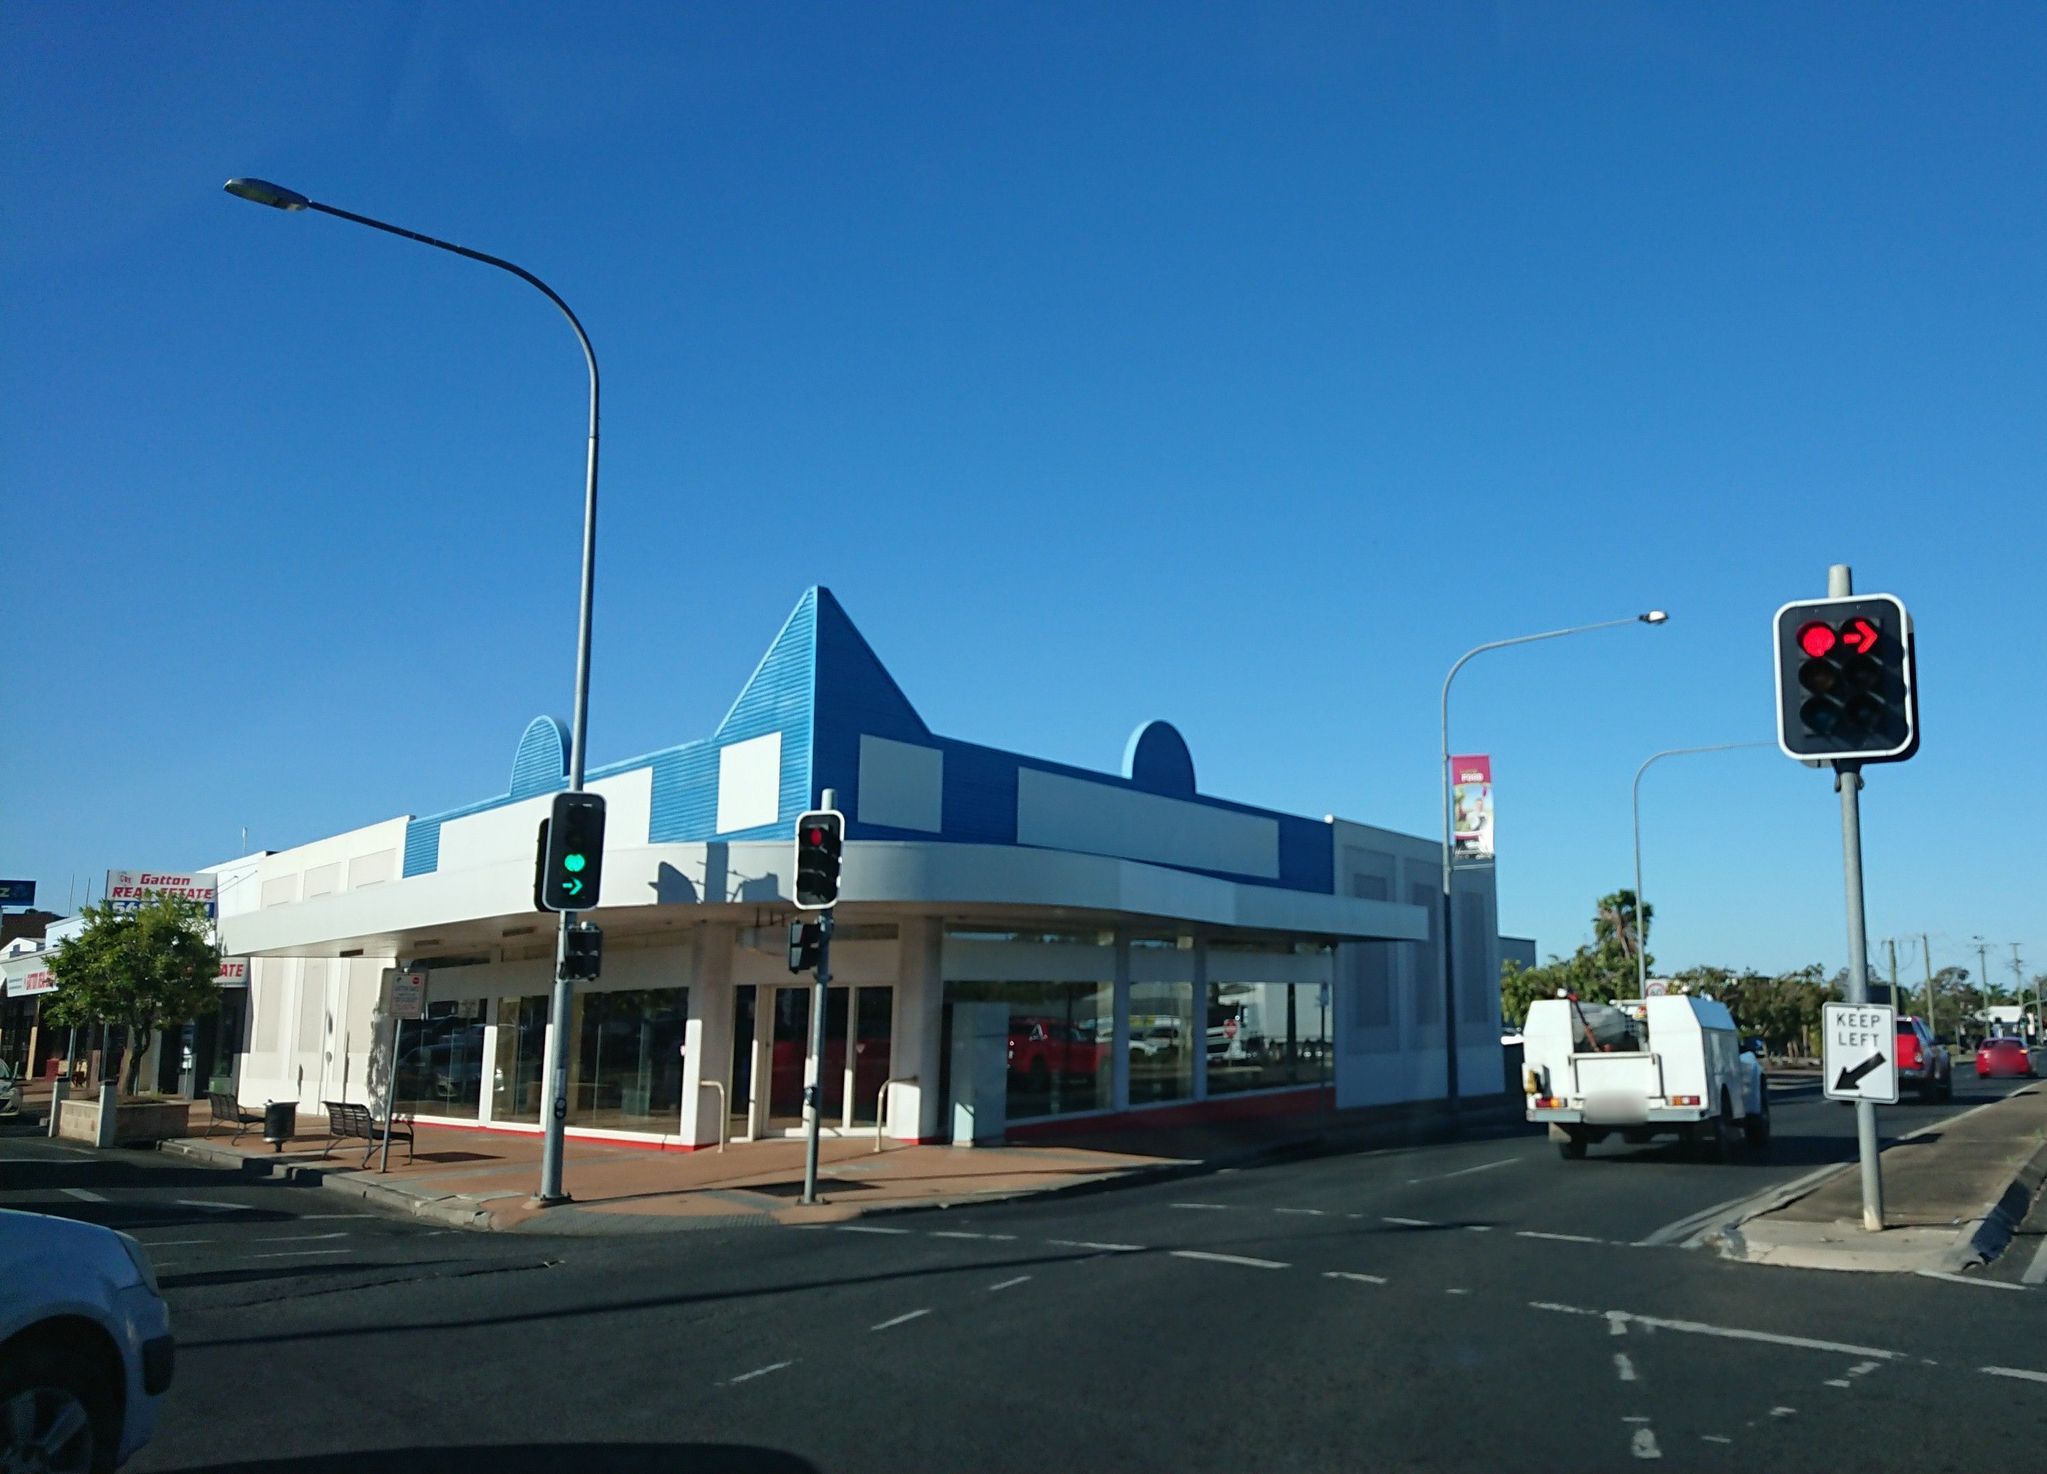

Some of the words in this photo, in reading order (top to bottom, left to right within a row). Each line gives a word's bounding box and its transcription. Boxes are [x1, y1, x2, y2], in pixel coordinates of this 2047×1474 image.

[140, 873, 191, 885] Gatton
[112, 886, 150, 898] REA
[1836, 1013, 1880, 1028] KEEP
[1838, 1032, 1879, 1047] LEFT
